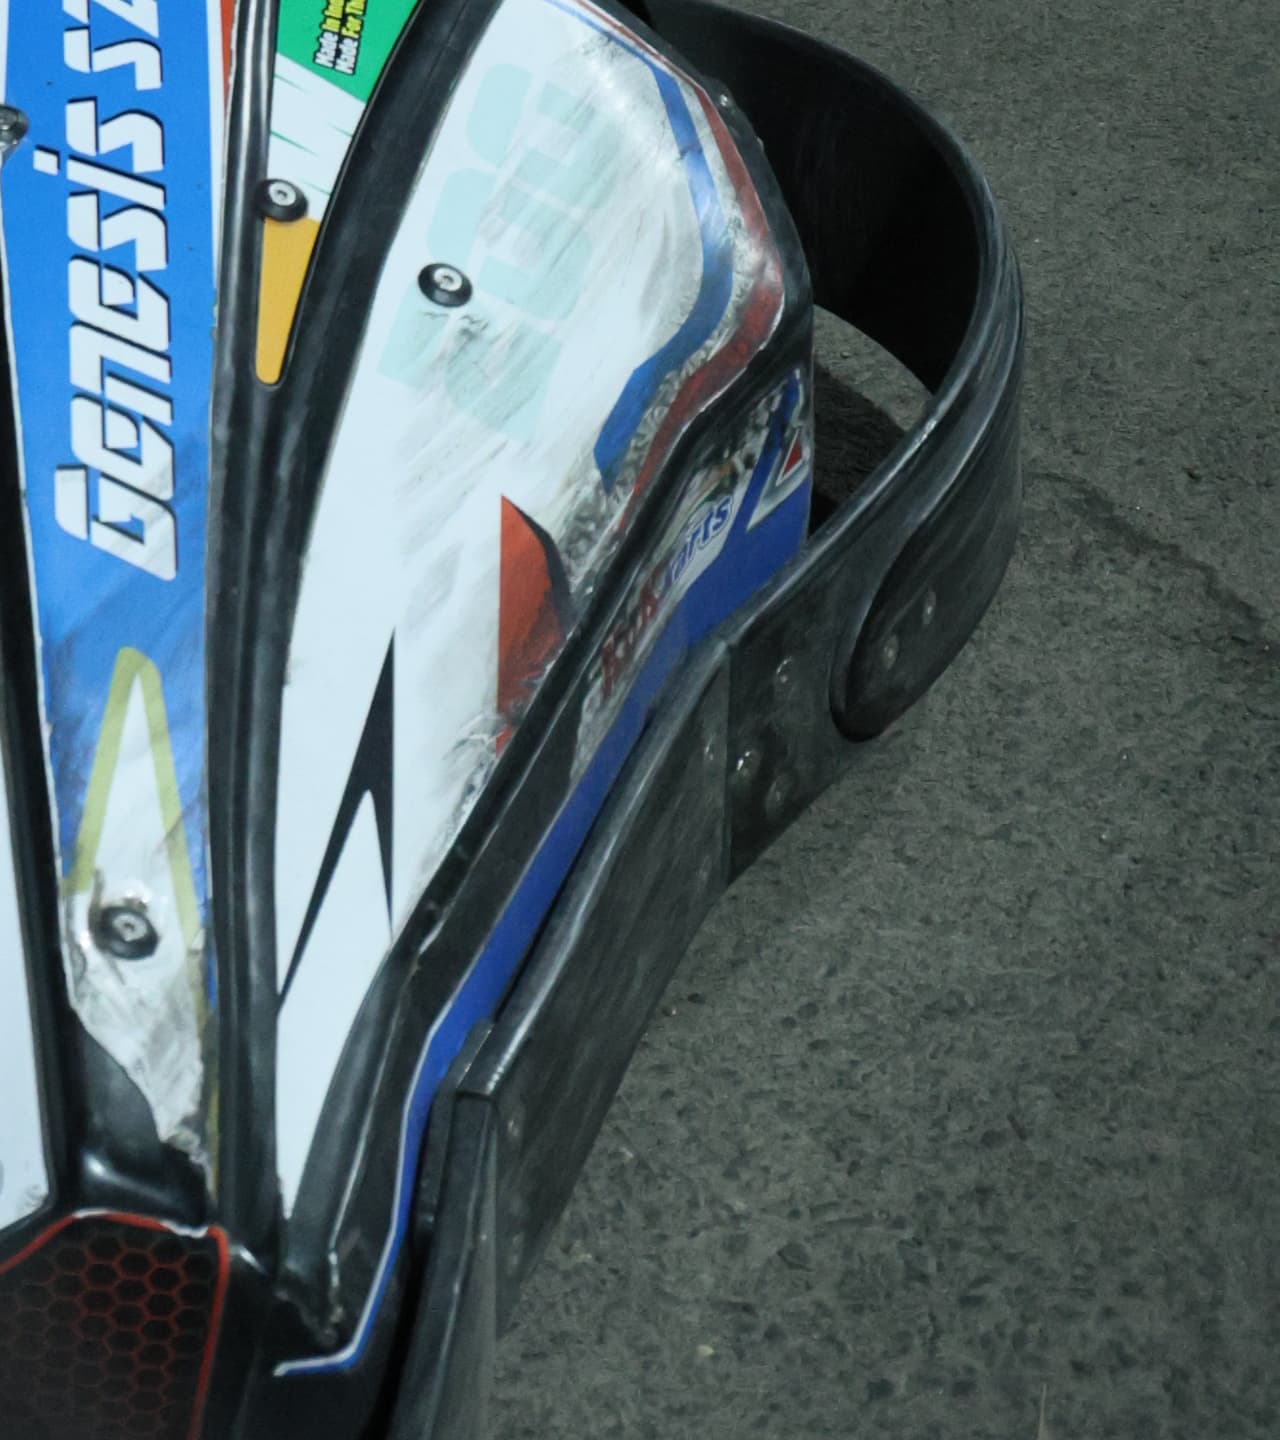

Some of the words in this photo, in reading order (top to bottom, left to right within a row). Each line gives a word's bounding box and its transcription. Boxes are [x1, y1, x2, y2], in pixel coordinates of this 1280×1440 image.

[320, 16, 342, 33] In
[340, 14, 363, 39] For
[314, 31, 340, 68] Made
[334, 36, 359, 75] Made
[32, 96, 180, 582] Genesis
